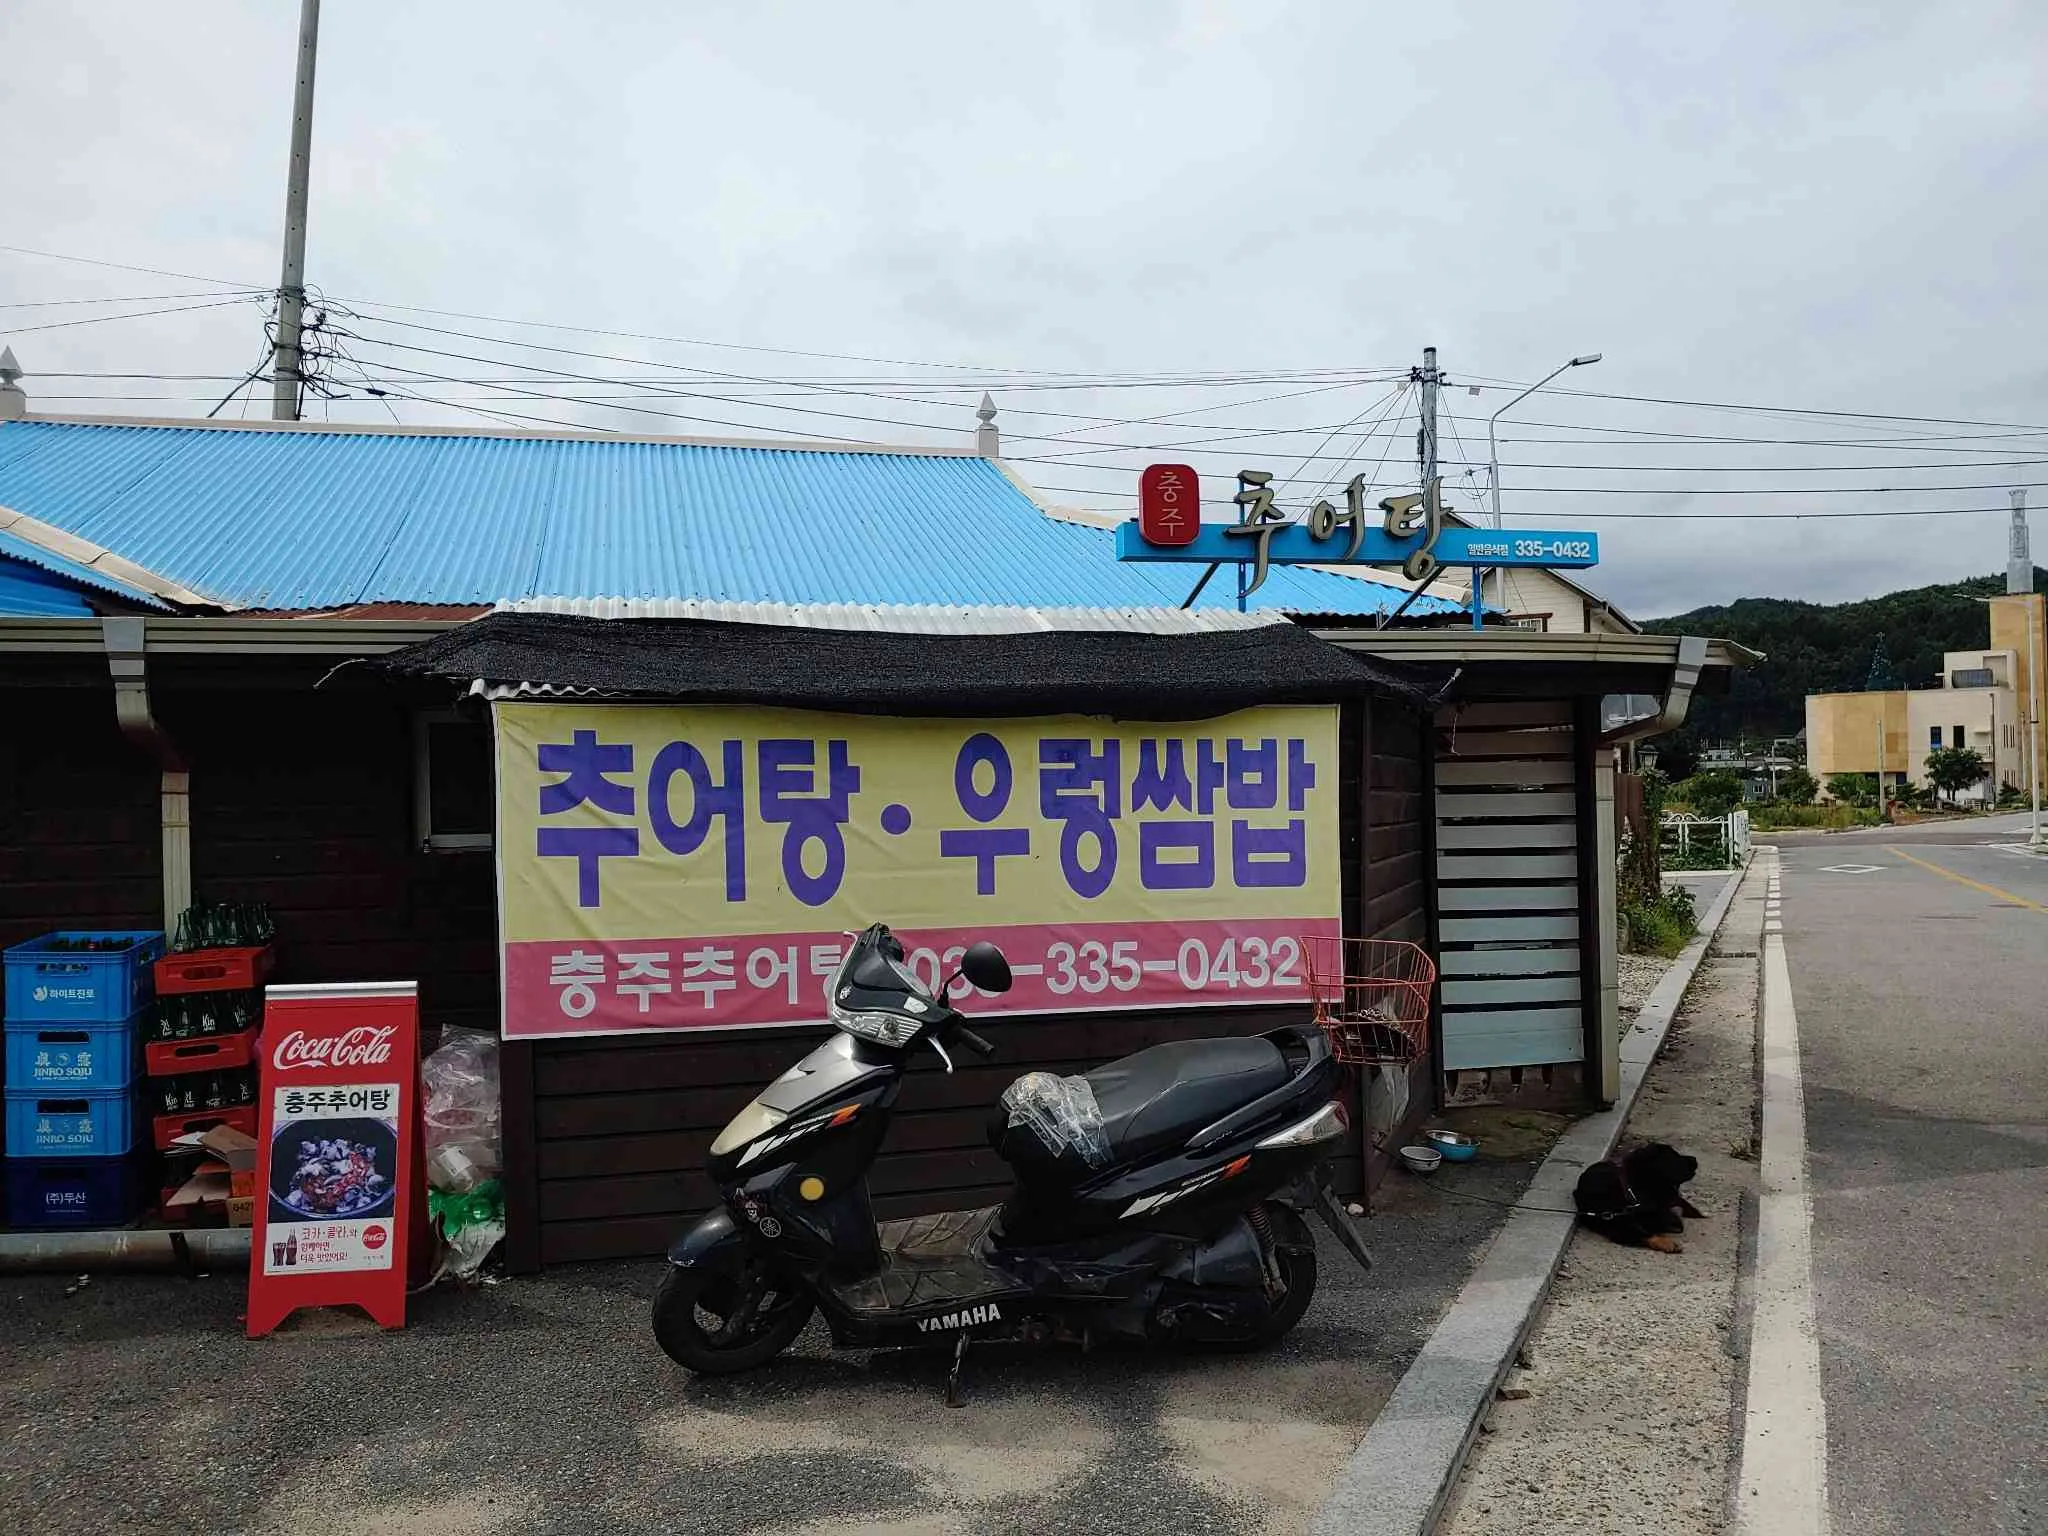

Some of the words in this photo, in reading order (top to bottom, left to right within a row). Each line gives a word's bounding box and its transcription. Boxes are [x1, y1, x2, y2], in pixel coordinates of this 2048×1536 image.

[1158, 471, 1185, 537] 충주
[1222, 470, 1454, 599] 추어탕
[1515, 540, 1590, 558] 335-0432
[905, 937, 1301, 999] 03-335-0432
[33, 1067, 63, 1077] JINRO
[66, 1067, 92, 1077] SOJU
[284, 1089, 390, 1113] 충주추어탕
[915, 1303, 1002, 1332] YAMAHA
